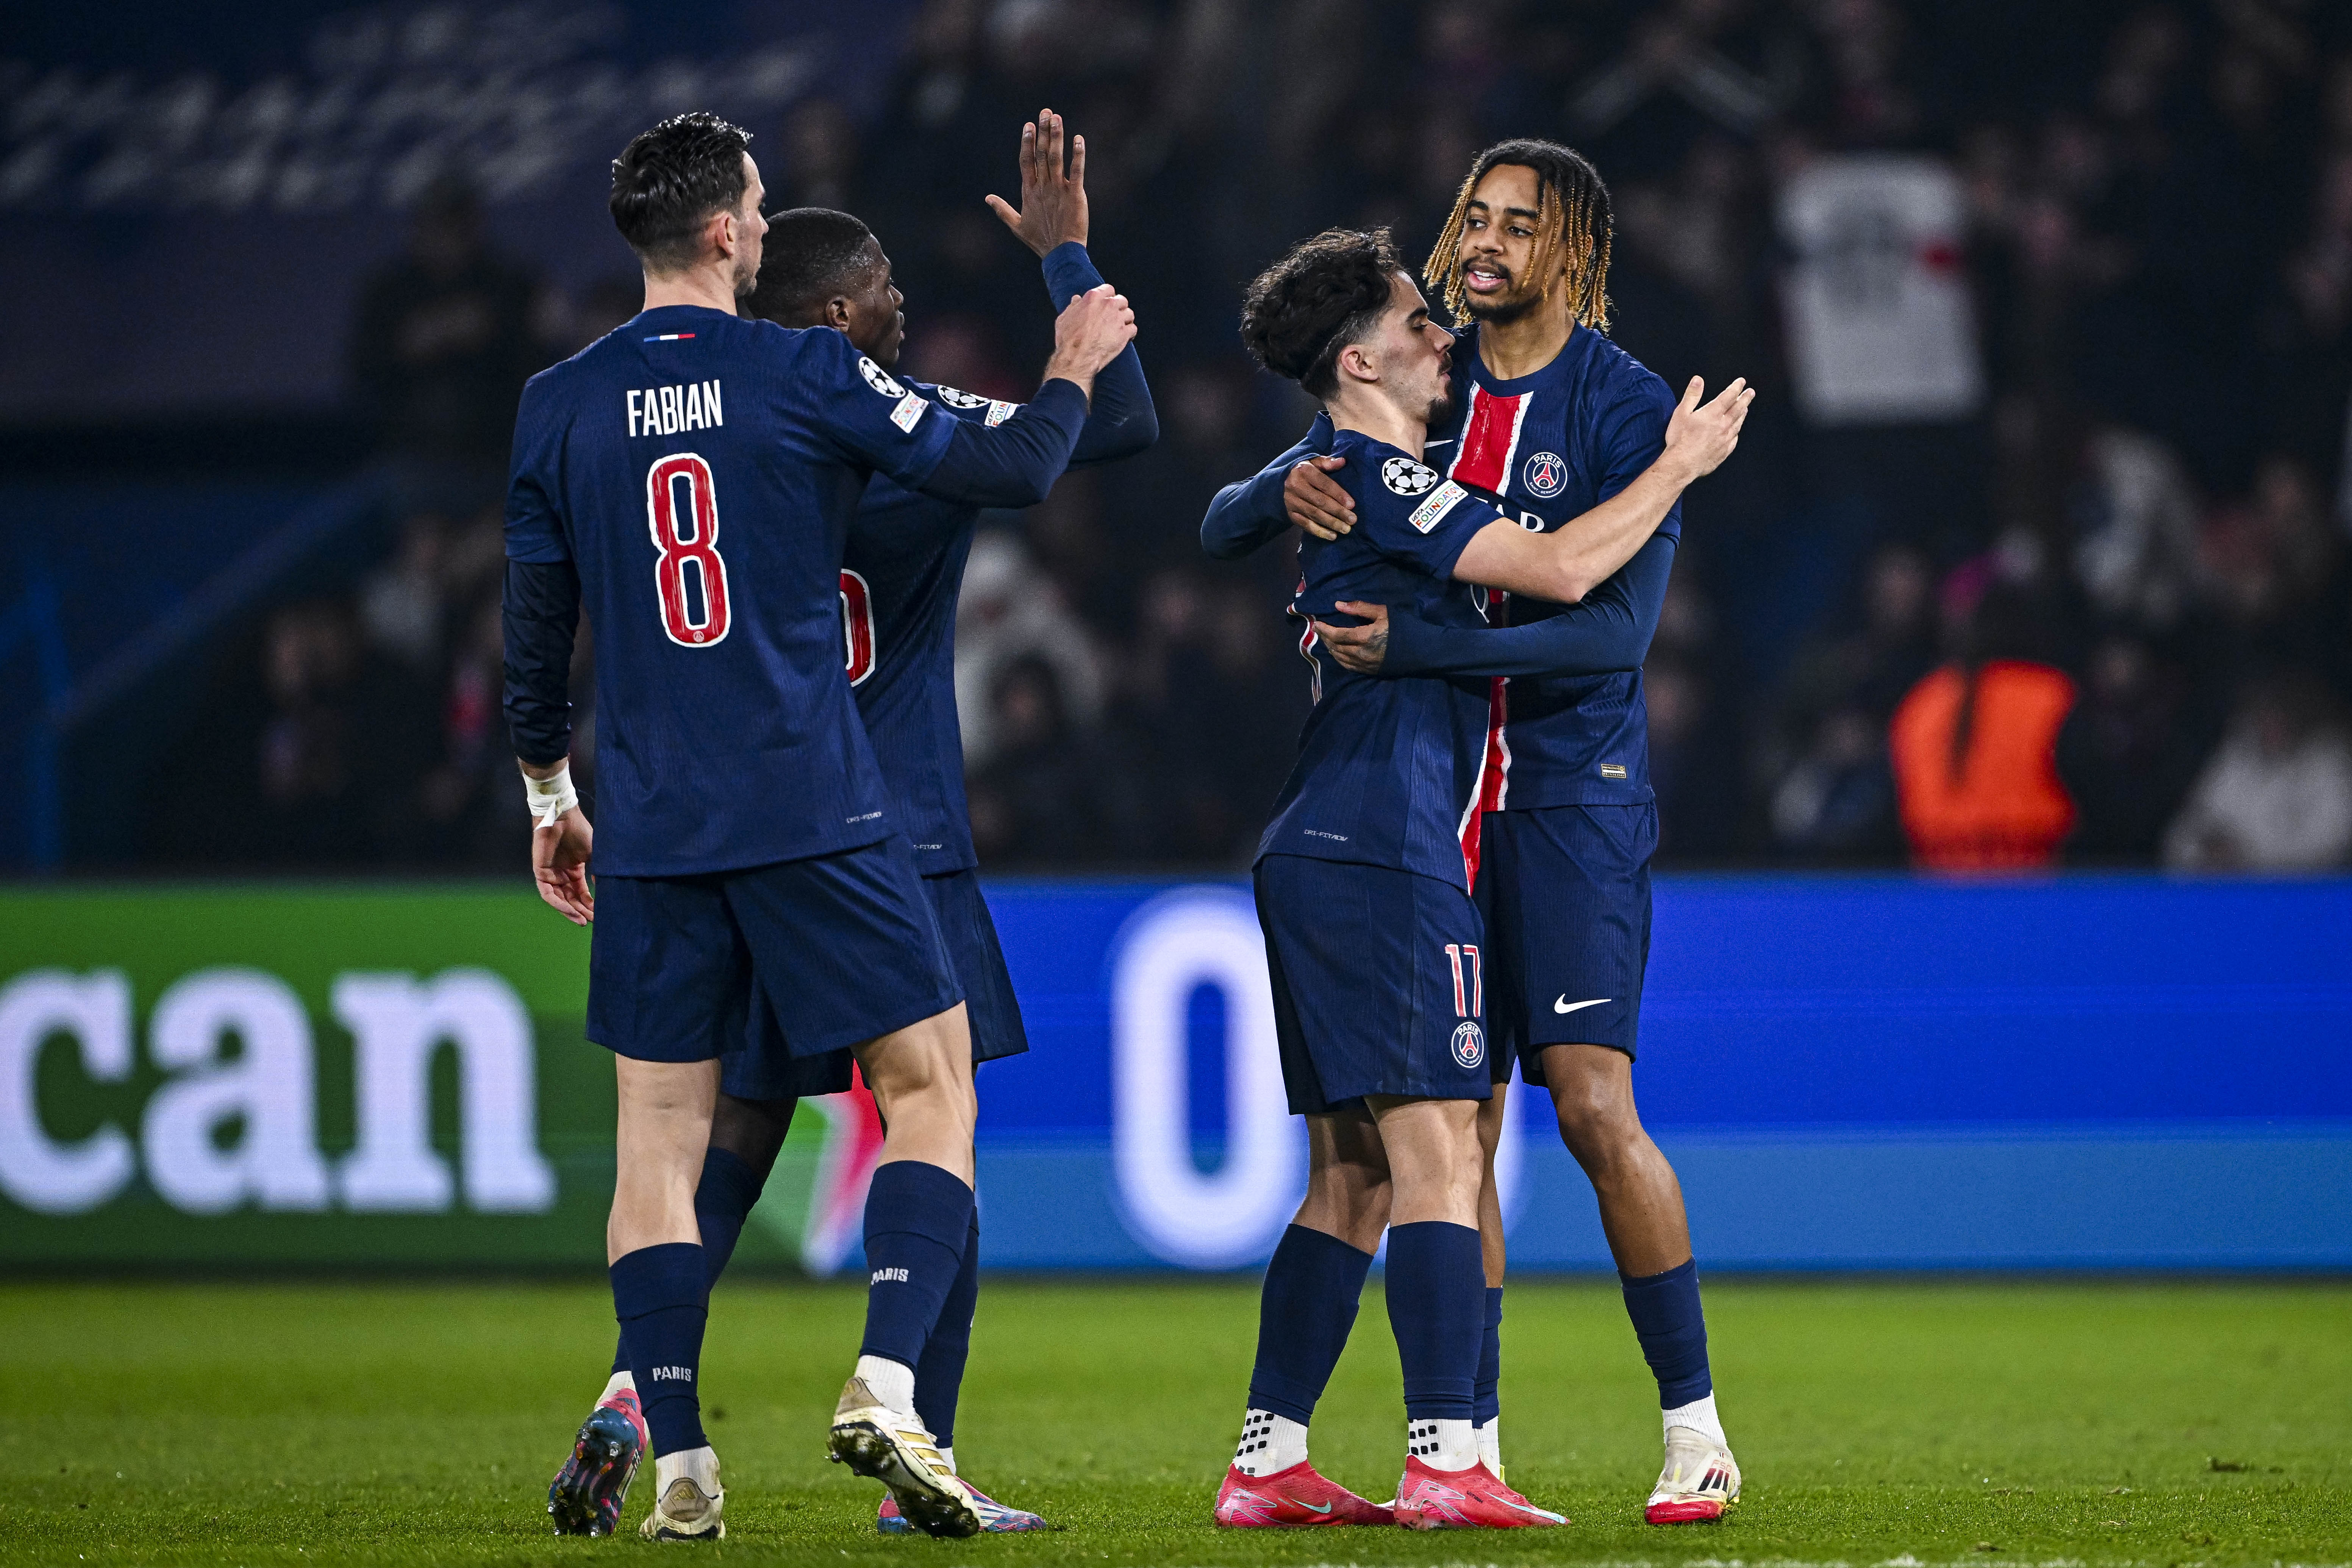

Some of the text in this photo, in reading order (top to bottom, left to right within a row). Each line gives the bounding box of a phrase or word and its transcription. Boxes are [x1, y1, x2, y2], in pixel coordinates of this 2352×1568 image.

[627, 379, 723, 437] FABIAN
[1533, 454, 1562, 468] PARIS
[1411, 508, 1425, 522] UEFA
[1416, 485, 1460, 528] FOUNDATION
[647, 453, 731, 648] 8
[1444, 943, 1482, 1017] 17
[1457, 1024, 1479, 1036] PARIS
[0, 966, 557, 1213] can
[871, 1268, 909, 1285] PARIS
[652, 1366, 692, 1382] PARIS
